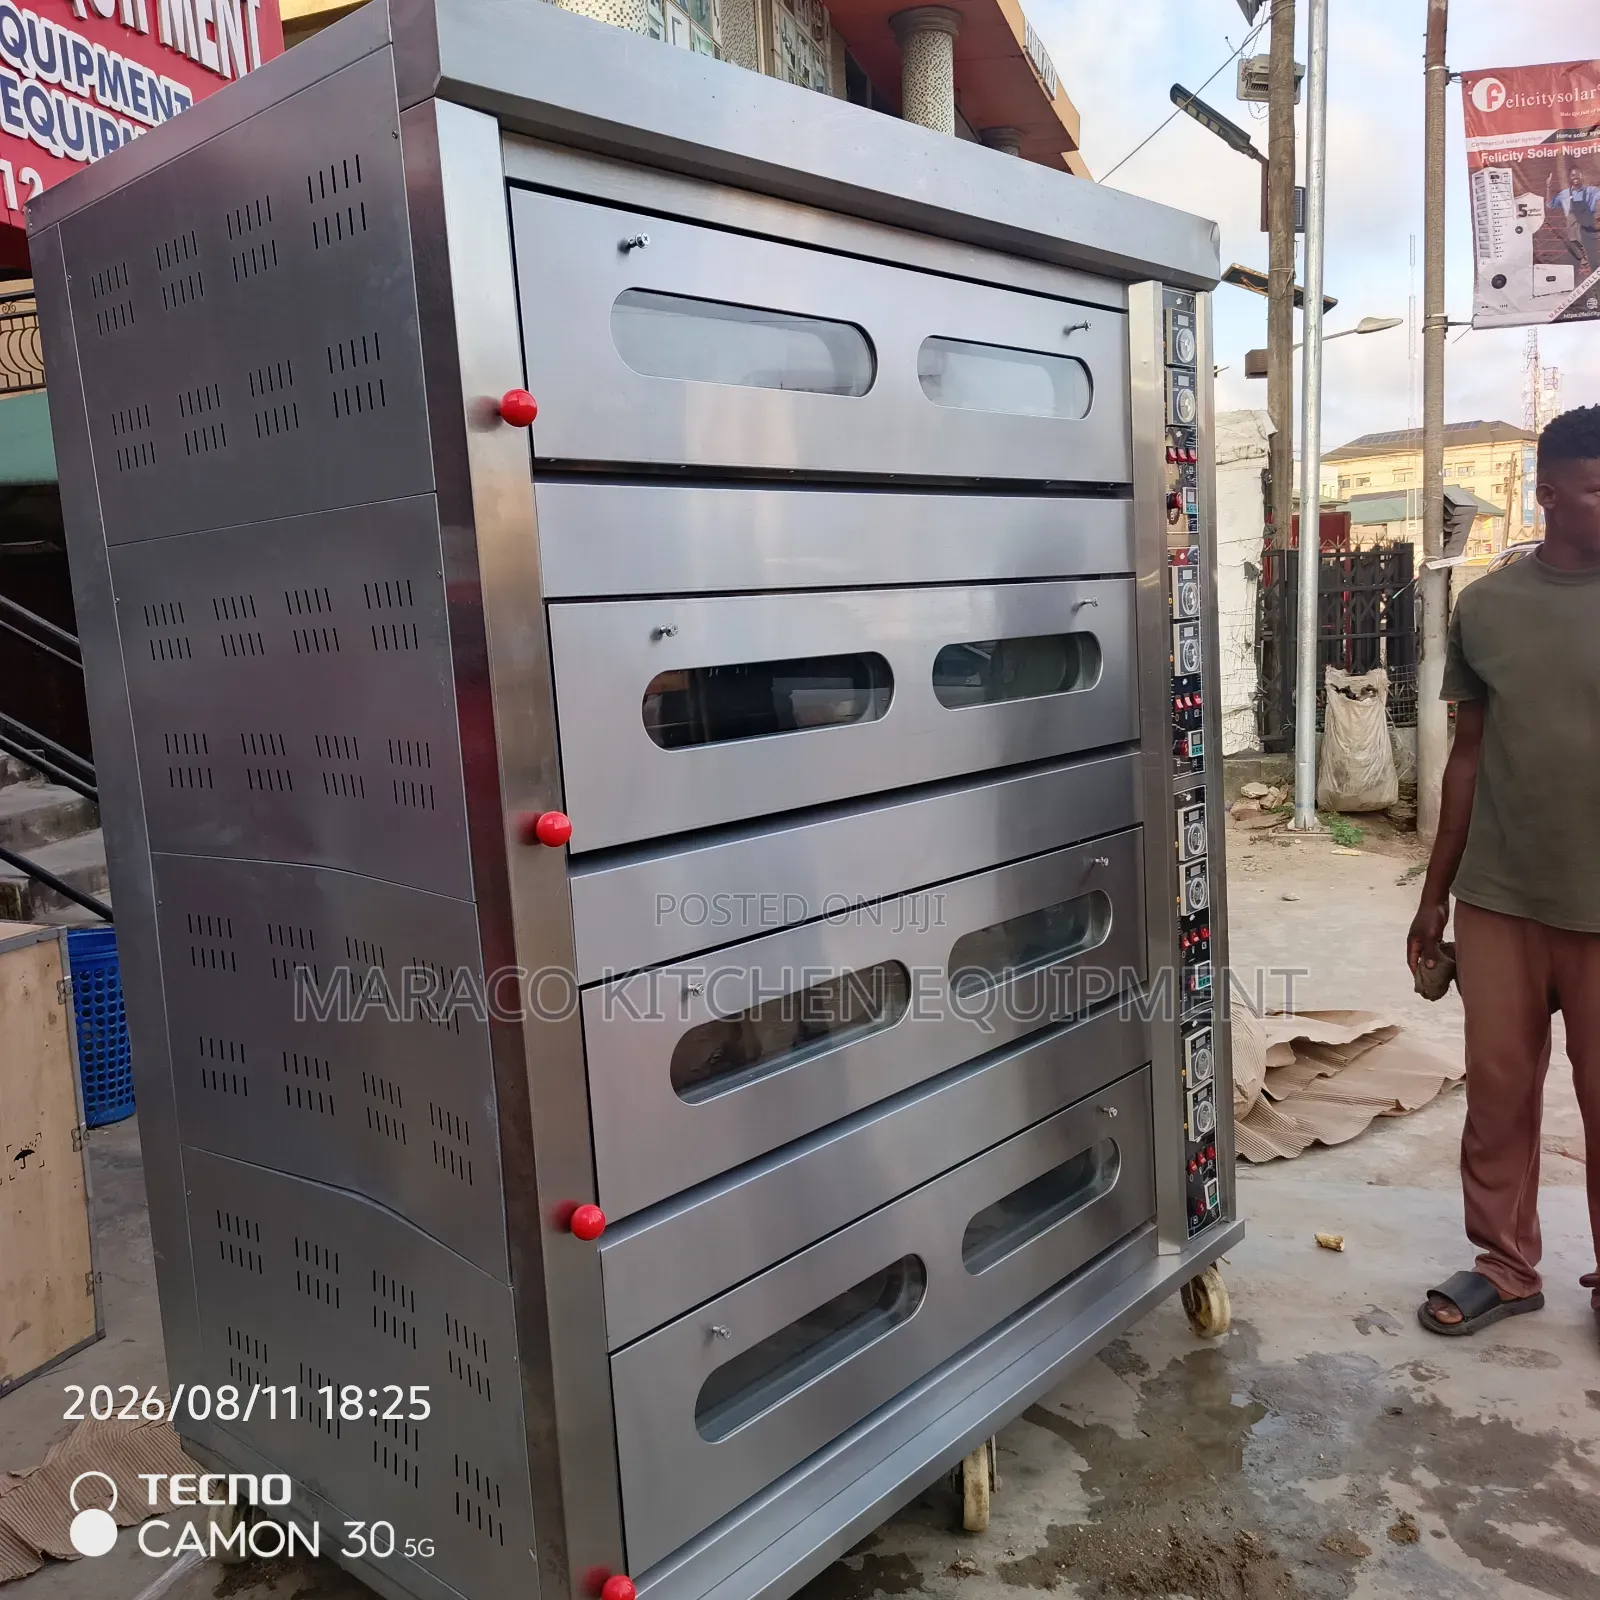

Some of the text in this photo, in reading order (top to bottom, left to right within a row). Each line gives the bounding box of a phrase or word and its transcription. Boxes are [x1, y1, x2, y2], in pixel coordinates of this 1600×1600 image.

[0, 73, 146, 159] EQUIP
[1481, 142, 1600, 163] Felicity Solar Nigeria
[1548, 275, 1597, 319] MAKE LIFE FULL
